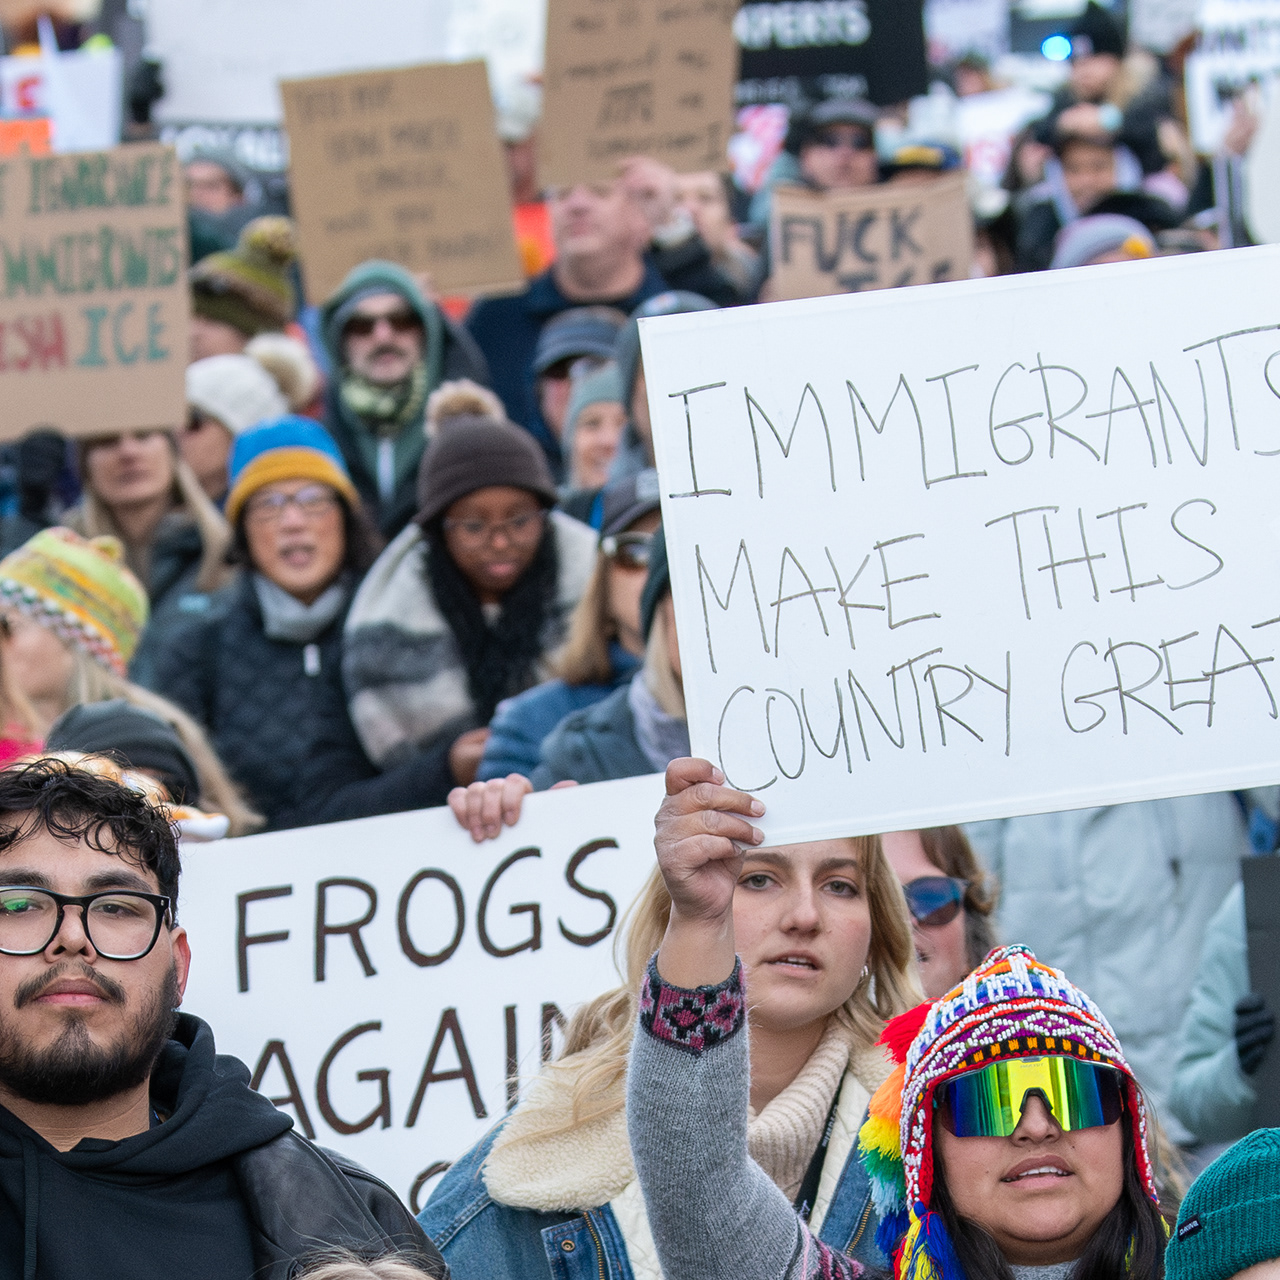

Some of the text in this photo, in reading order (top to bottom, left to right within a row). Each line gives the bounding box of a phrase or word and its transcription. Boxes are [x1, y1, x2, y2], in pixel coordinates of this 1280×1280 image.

[780, 204, 922, 272] FUCK
[76, 301, 171, 369] ICE
[695, 498, 1225, 674] MAKE THIS
[718, 647, 1013, 793] COUNTRY
[236, 838, 619, 994] FROGS
